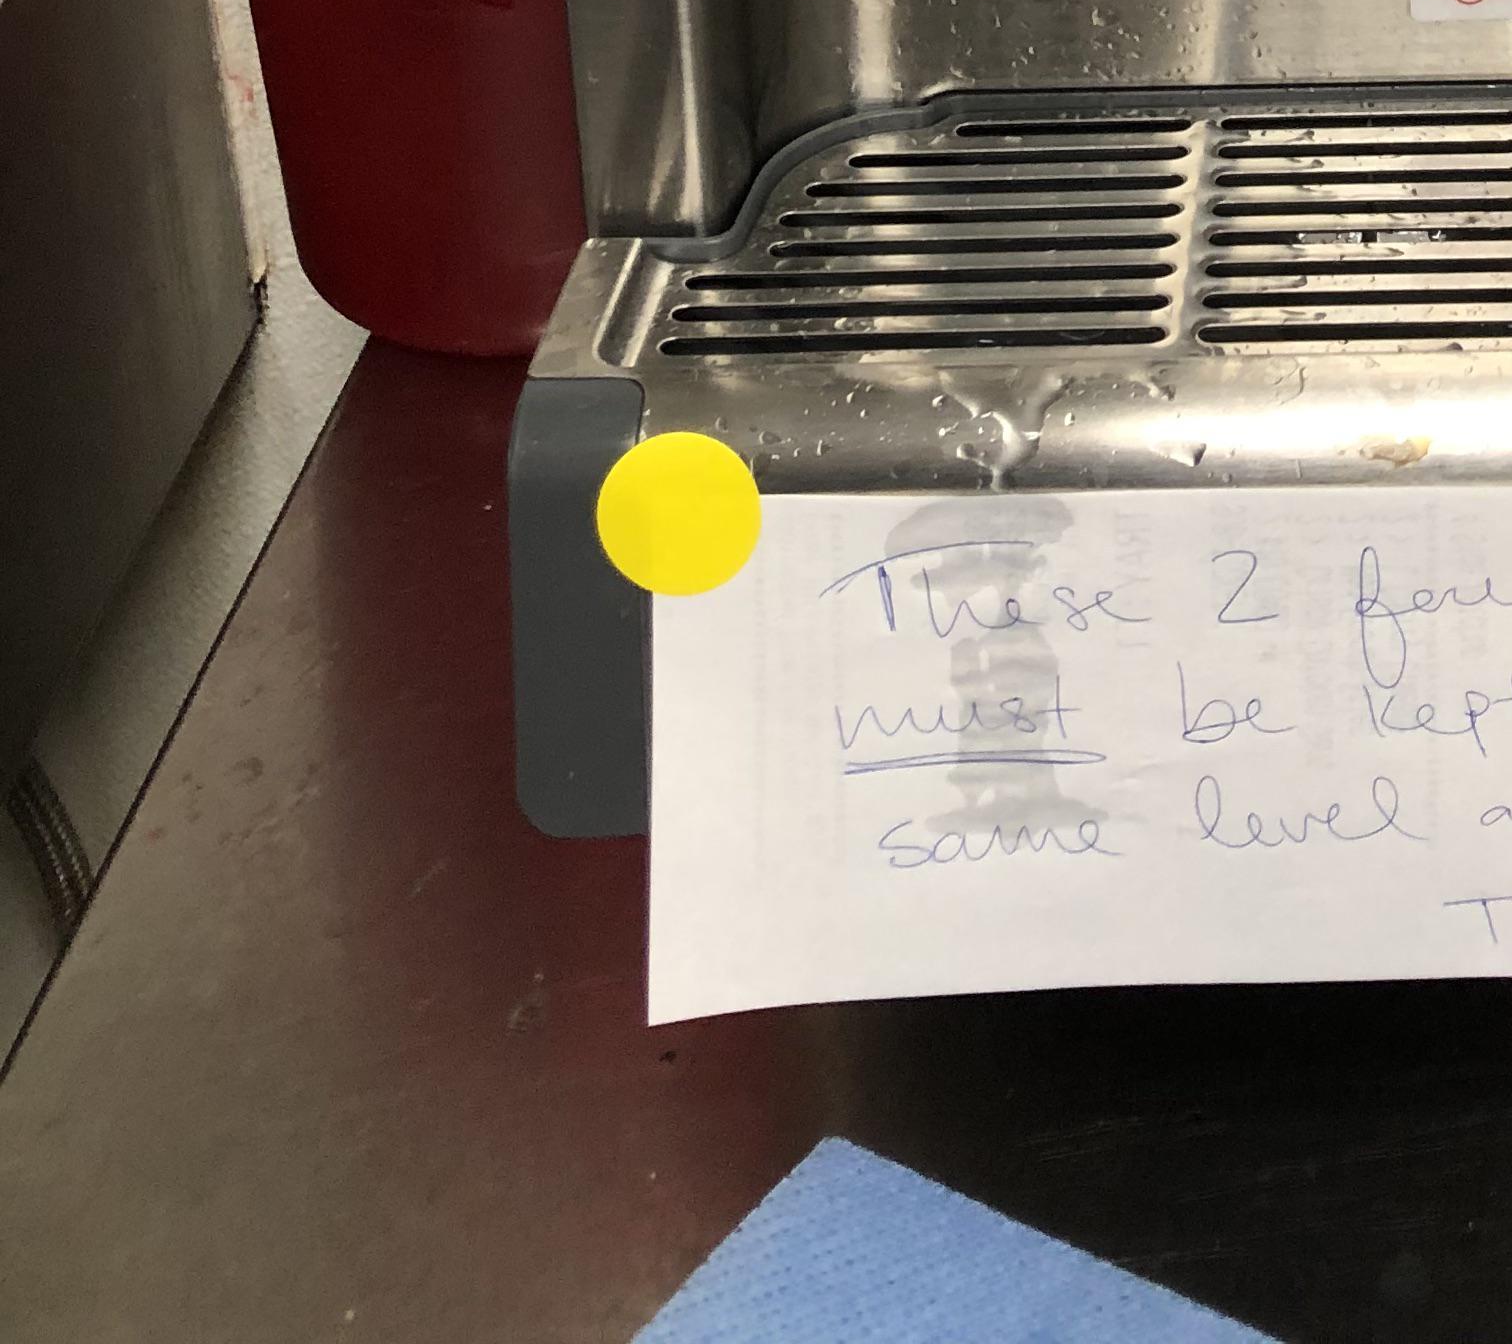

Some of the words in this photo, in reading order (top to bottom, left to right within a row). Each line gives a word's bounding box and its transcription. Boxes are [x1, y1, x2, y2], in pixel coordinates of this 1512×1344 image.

[819, 541, 1152, 639] These
[1211, 550, 1280, 623] 2
[835, 674, 1081, 750] must
[1177, 661, 1298, 743] be
[879, 818, 1124, 869] same
[1195, 775, 1429, 848] level
